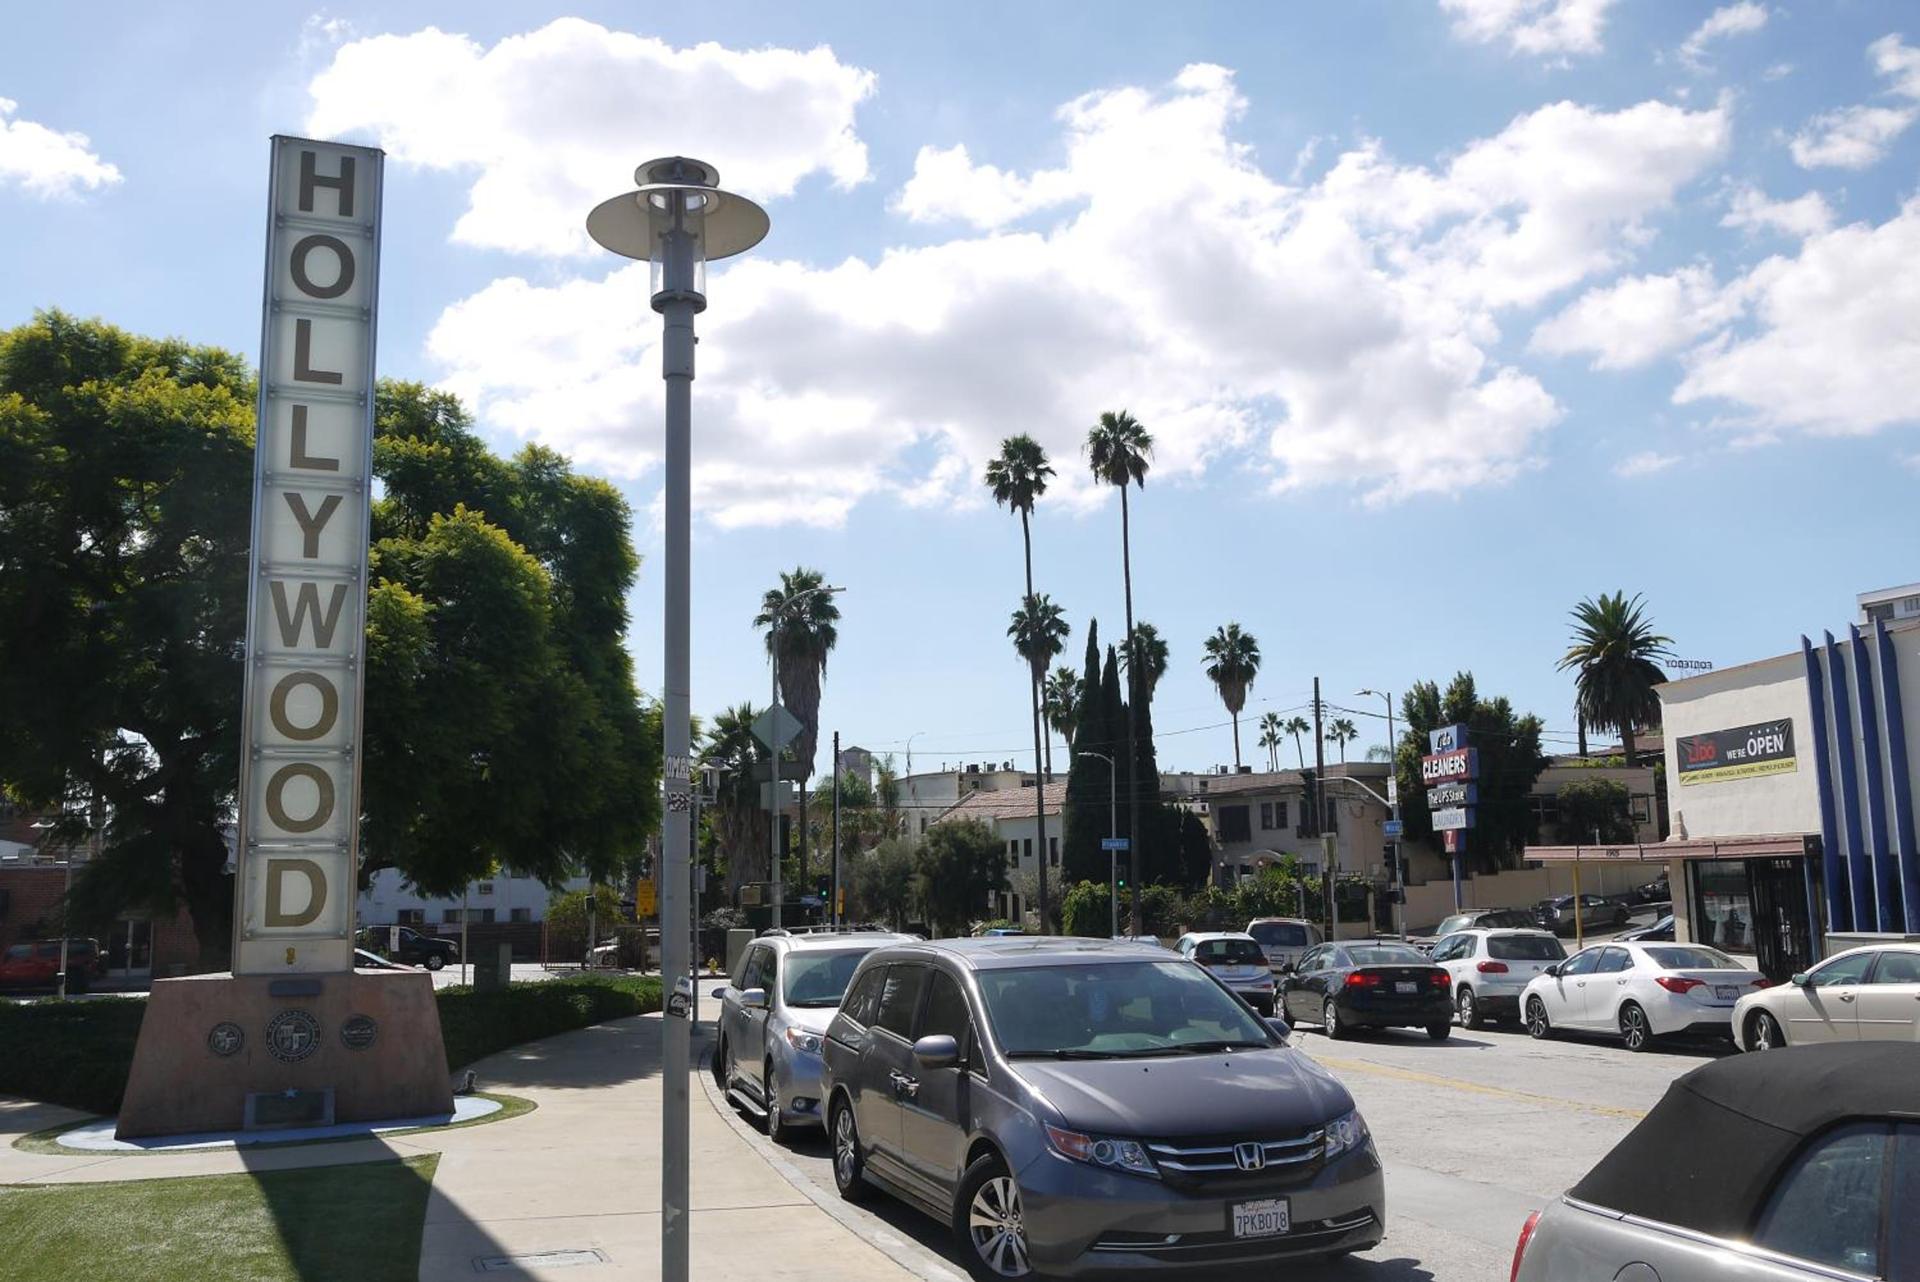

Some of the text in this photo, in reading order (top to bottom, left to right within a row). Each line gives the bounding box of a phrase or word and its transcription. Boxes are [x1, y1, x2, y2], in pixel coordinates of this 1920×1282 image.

[264, 150, 356, 928] HOLLYWOOD
[1726, 733, 1784, 760] WE'RE OPEN
[1422, 755, 1466, 779] CLEANERS
[1235, 1212, 1287, 1233] 7PKB078
